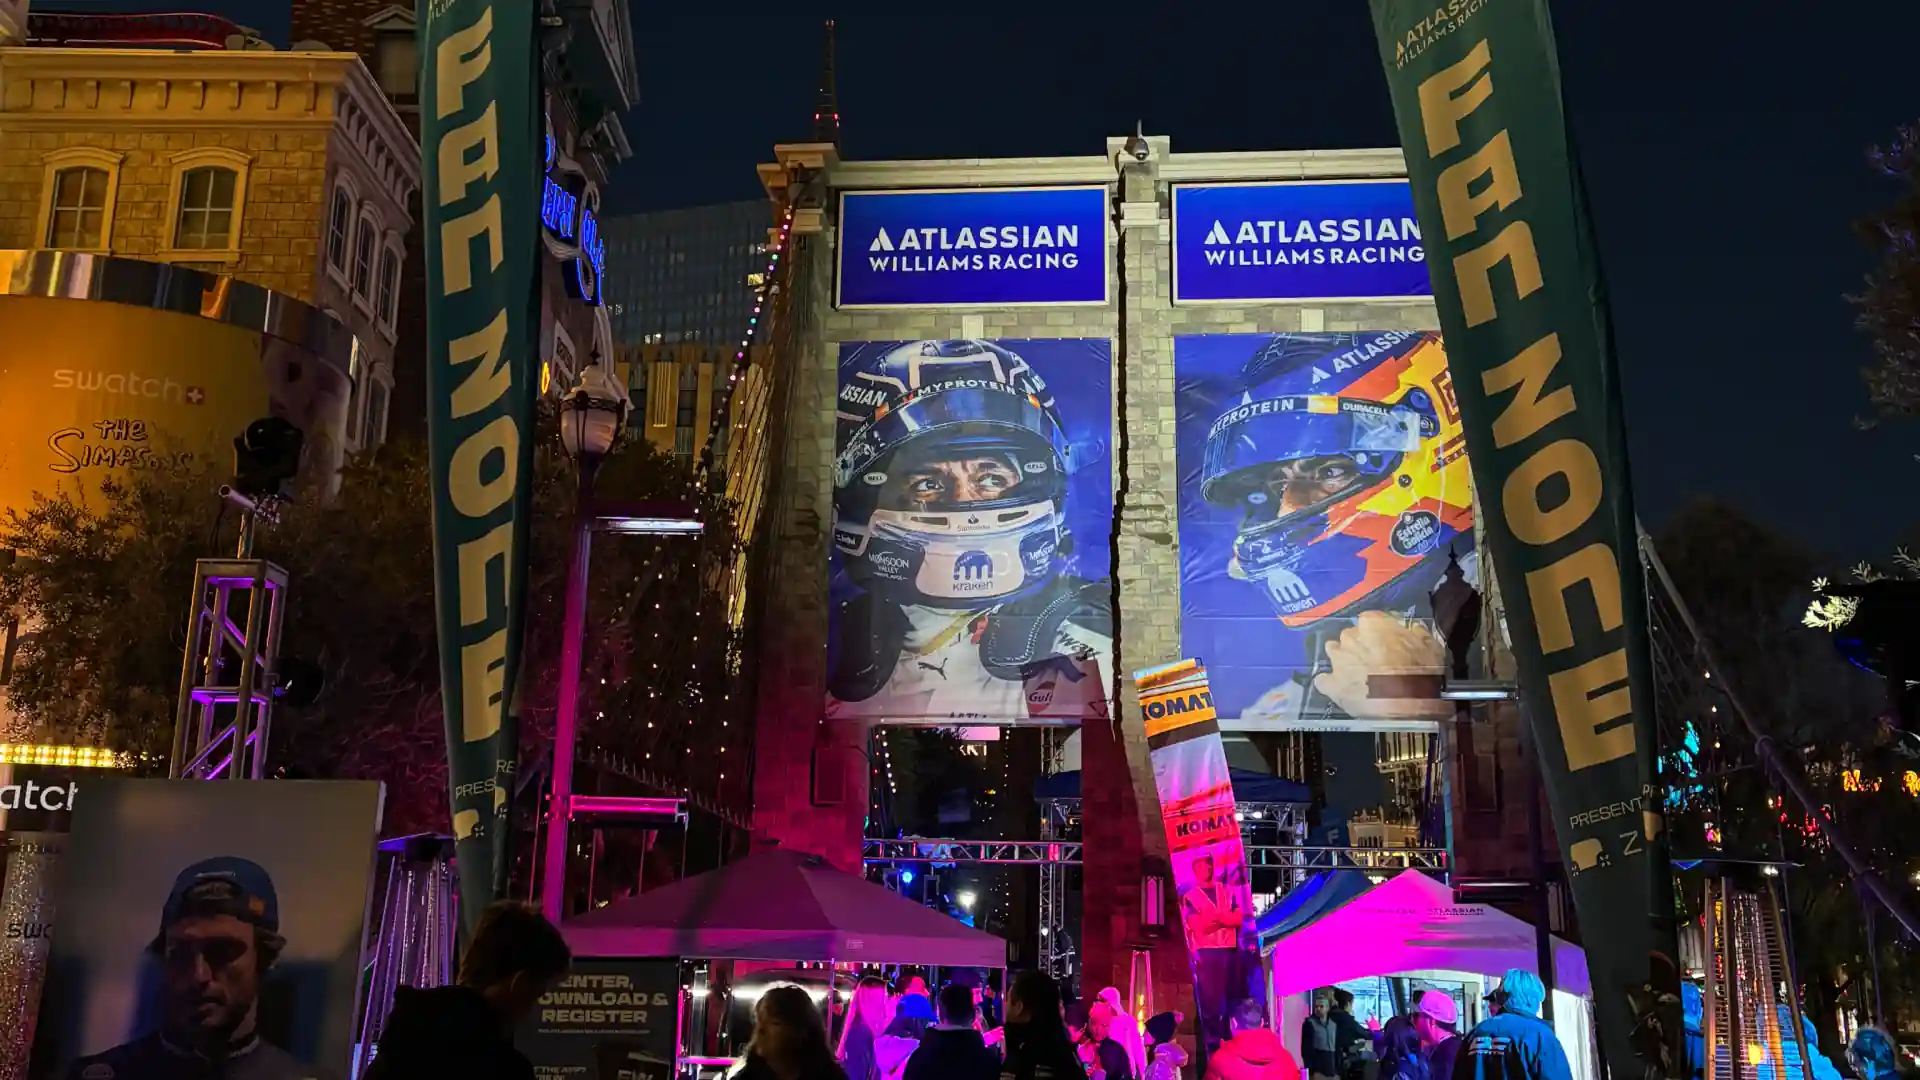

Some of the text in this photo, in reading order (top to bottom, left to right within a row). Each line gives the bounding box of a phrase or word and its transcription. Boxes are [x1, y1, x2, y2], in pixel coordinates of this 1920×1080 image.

[1396, 21, 1457, 70] WILLIAMS
[899, 224, 1079, 251] ATLASSIAN
[1236, 217, 1422, 245] ATLASSIAN
[869, 252, 1079, 272] WILLIAMS RACING
[1204, 246, 1425, 266] WILLIAMS RACING
[52, 368, 182, 400] swatch
[917, 379, 1017, 397] MYPROTEIN
[93, 418, 149, 442] THE
[1208, 398, 1295, 440] MYPROTEIN
[869, 551, 910, 569] MONSOON
[878, 566, 900, 574] VALLEY
[1570, 797, 1643, 829] PRESENT
[652, 992, 669, 1006] &
[542, 1009, 648, 1023] REGISTER
